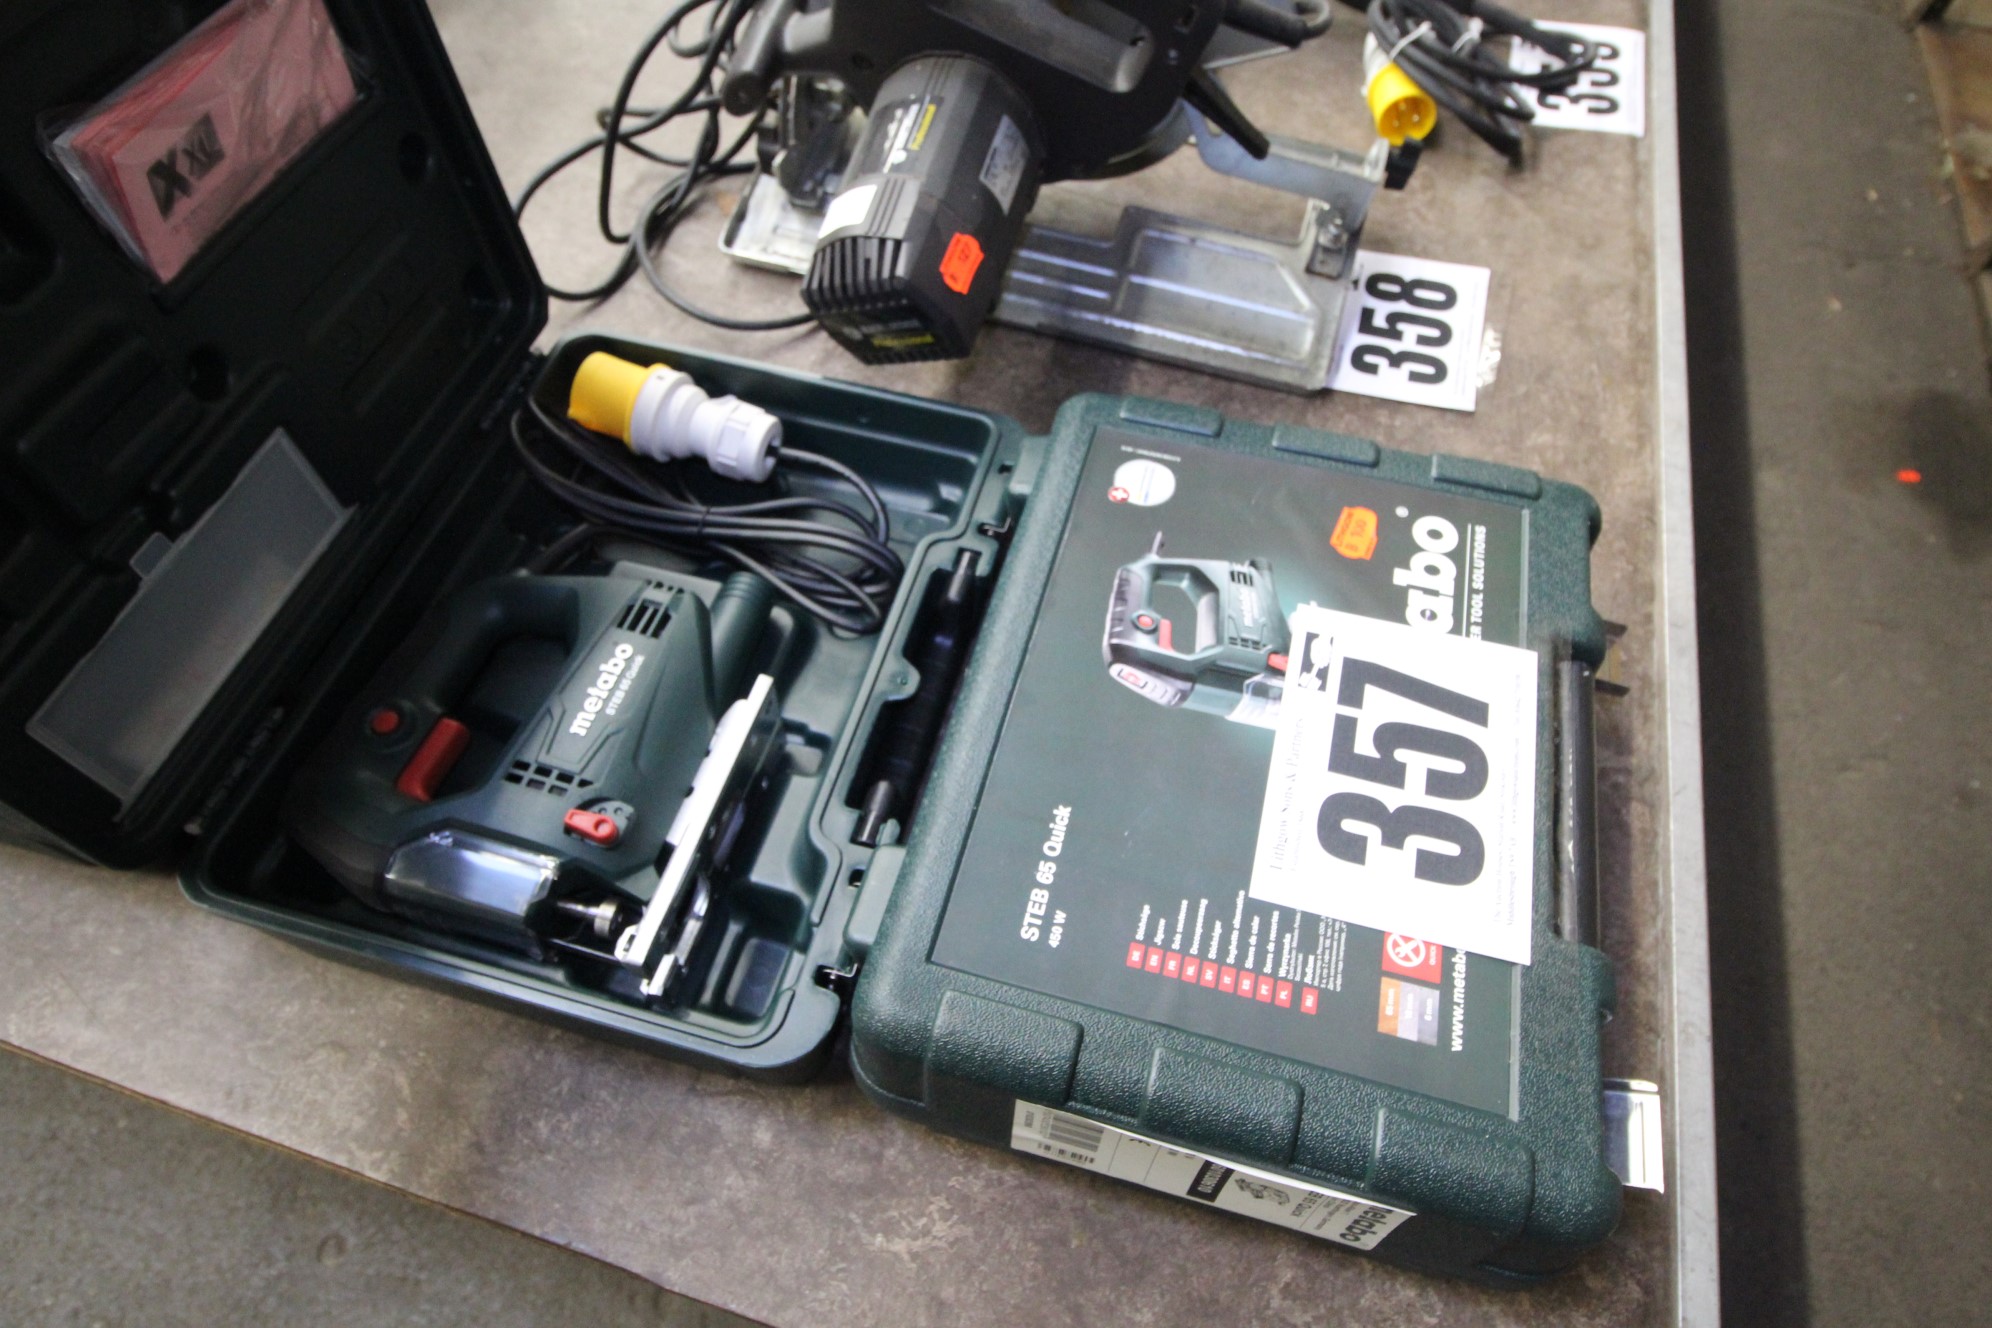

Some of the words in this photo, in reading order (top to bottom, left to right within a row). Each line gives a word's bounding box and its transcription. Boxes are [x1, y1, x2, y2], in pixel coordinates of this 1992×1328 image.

[1351, 272, 1458, 386] 358
[1472, 524, 1486, 591] SOLUTIONS
[1393, 515, 1459, 633] abo
[1470, 593, 1484, 624] TOOL
[569, 643, 634, 737] metabo
[1317, 657, 1490, 886] 357
[1042, 805, 1072, 857] Quick
[1036, 860, 1057, 885] 65
[1020, 888, 1050, 942] STEB
[1053, 909, 1067, 924] W
[1048, 925, 1063, 948] 450
[1154, 918, 1166, 945] Jigsaw
[1132, 951, 1141, 961] DE
[1150, 955, 1159, 966] EN
[1168, 960, 1177, 970] FR
[1187, 965, 1195, 975] NL
[1205, 969, 1213, 980] SV
[1223, 975, 1231, 984] IT
[1260, 985, 1269, 995] PT
[1305, 995, 1314, 1007] RU
